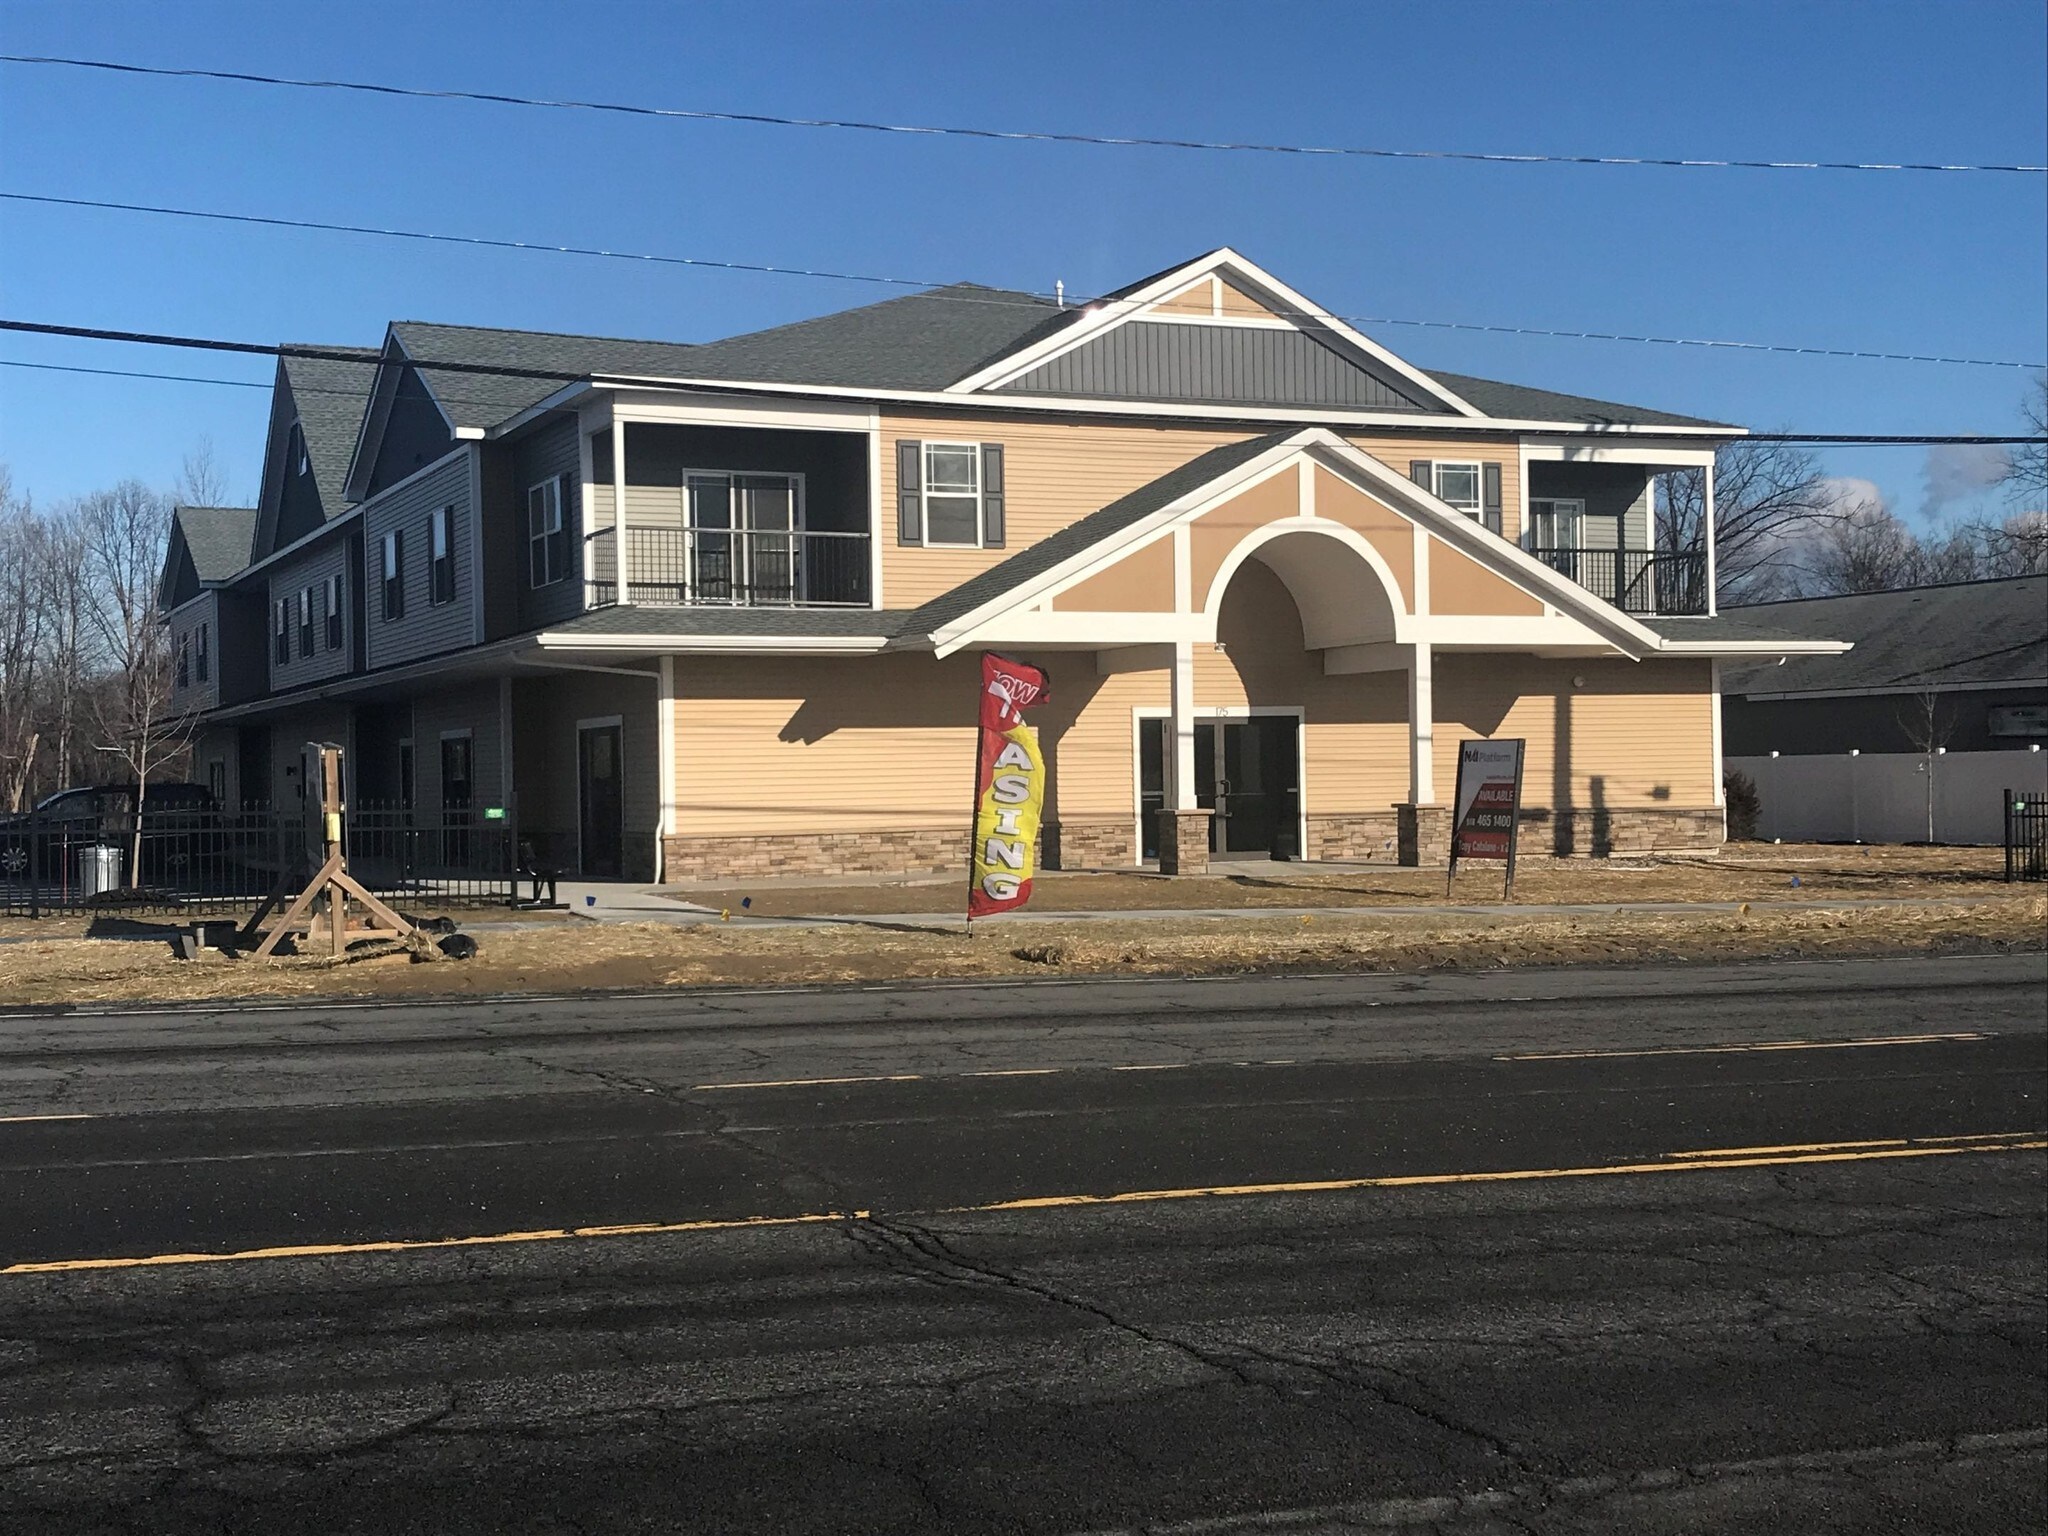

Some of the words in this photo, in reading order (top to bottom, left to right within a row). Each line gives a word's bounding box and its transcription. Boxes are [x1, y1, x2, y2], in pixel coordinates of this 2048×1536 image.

[993, 669, 1040, 704] OW
[983, 681, 1034, 900] ASING
[1478, 790, 1513, 801] AVAILABLE
[1477, 814, 1492, 827] 465
[1493, 815, 1511, 827] 1400
